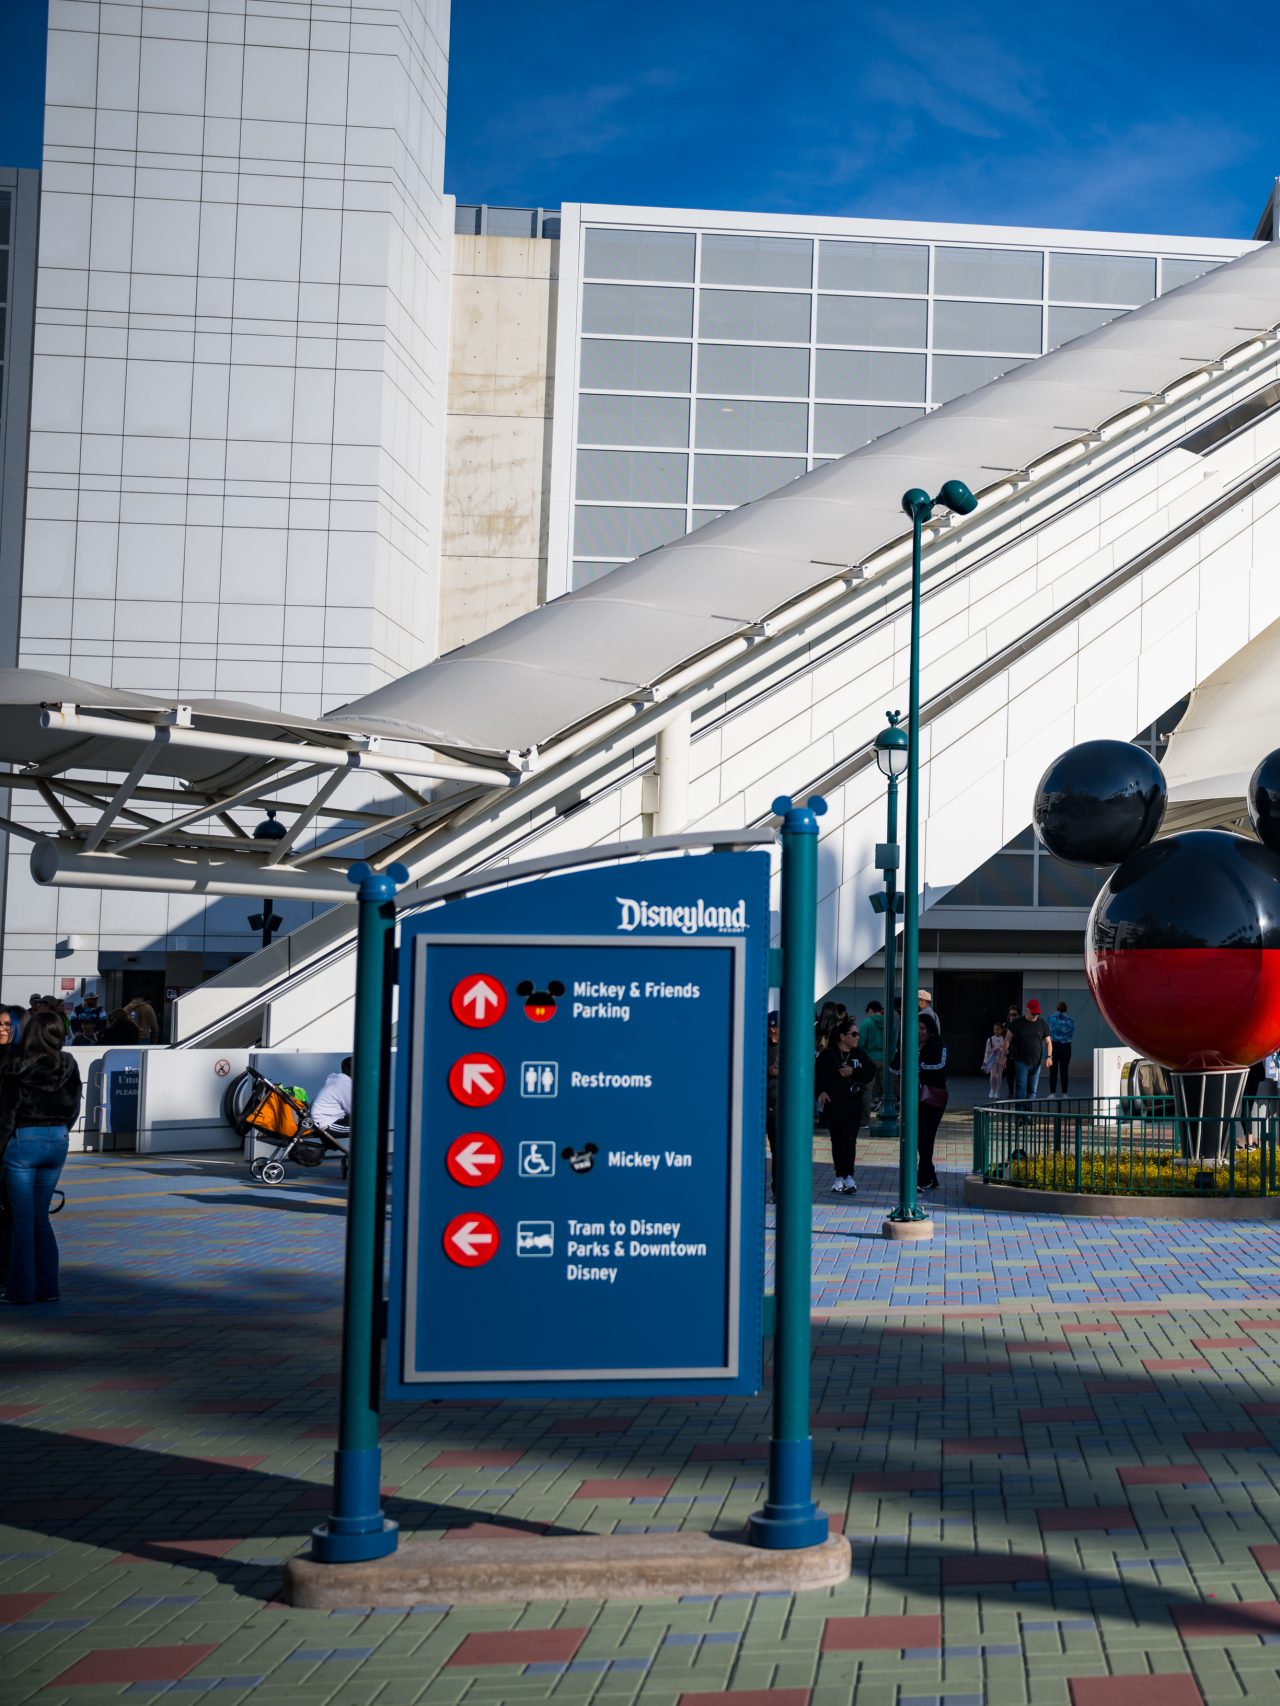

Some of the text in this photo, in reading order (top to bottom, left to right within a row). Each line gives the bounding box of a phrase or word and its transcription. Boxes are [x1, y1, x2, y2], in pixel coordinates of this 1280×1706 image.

[616, 896, 746, 935] Disneyland
[573, 981, 700, 1001] Mickey & Friends
[573, 1002, 630, 1022] Parking
[571, 1071, 652, 1088] Restrooms
[608, 1151, 660, 1171] Mickey
[664, 1151, 692, 1167] Van
[567, 1219, 681, 1239] Tram to Disney
[567, 1240, 707, 1257] Parks & Downtown
[566, 1264, 618, 1284] Disney
